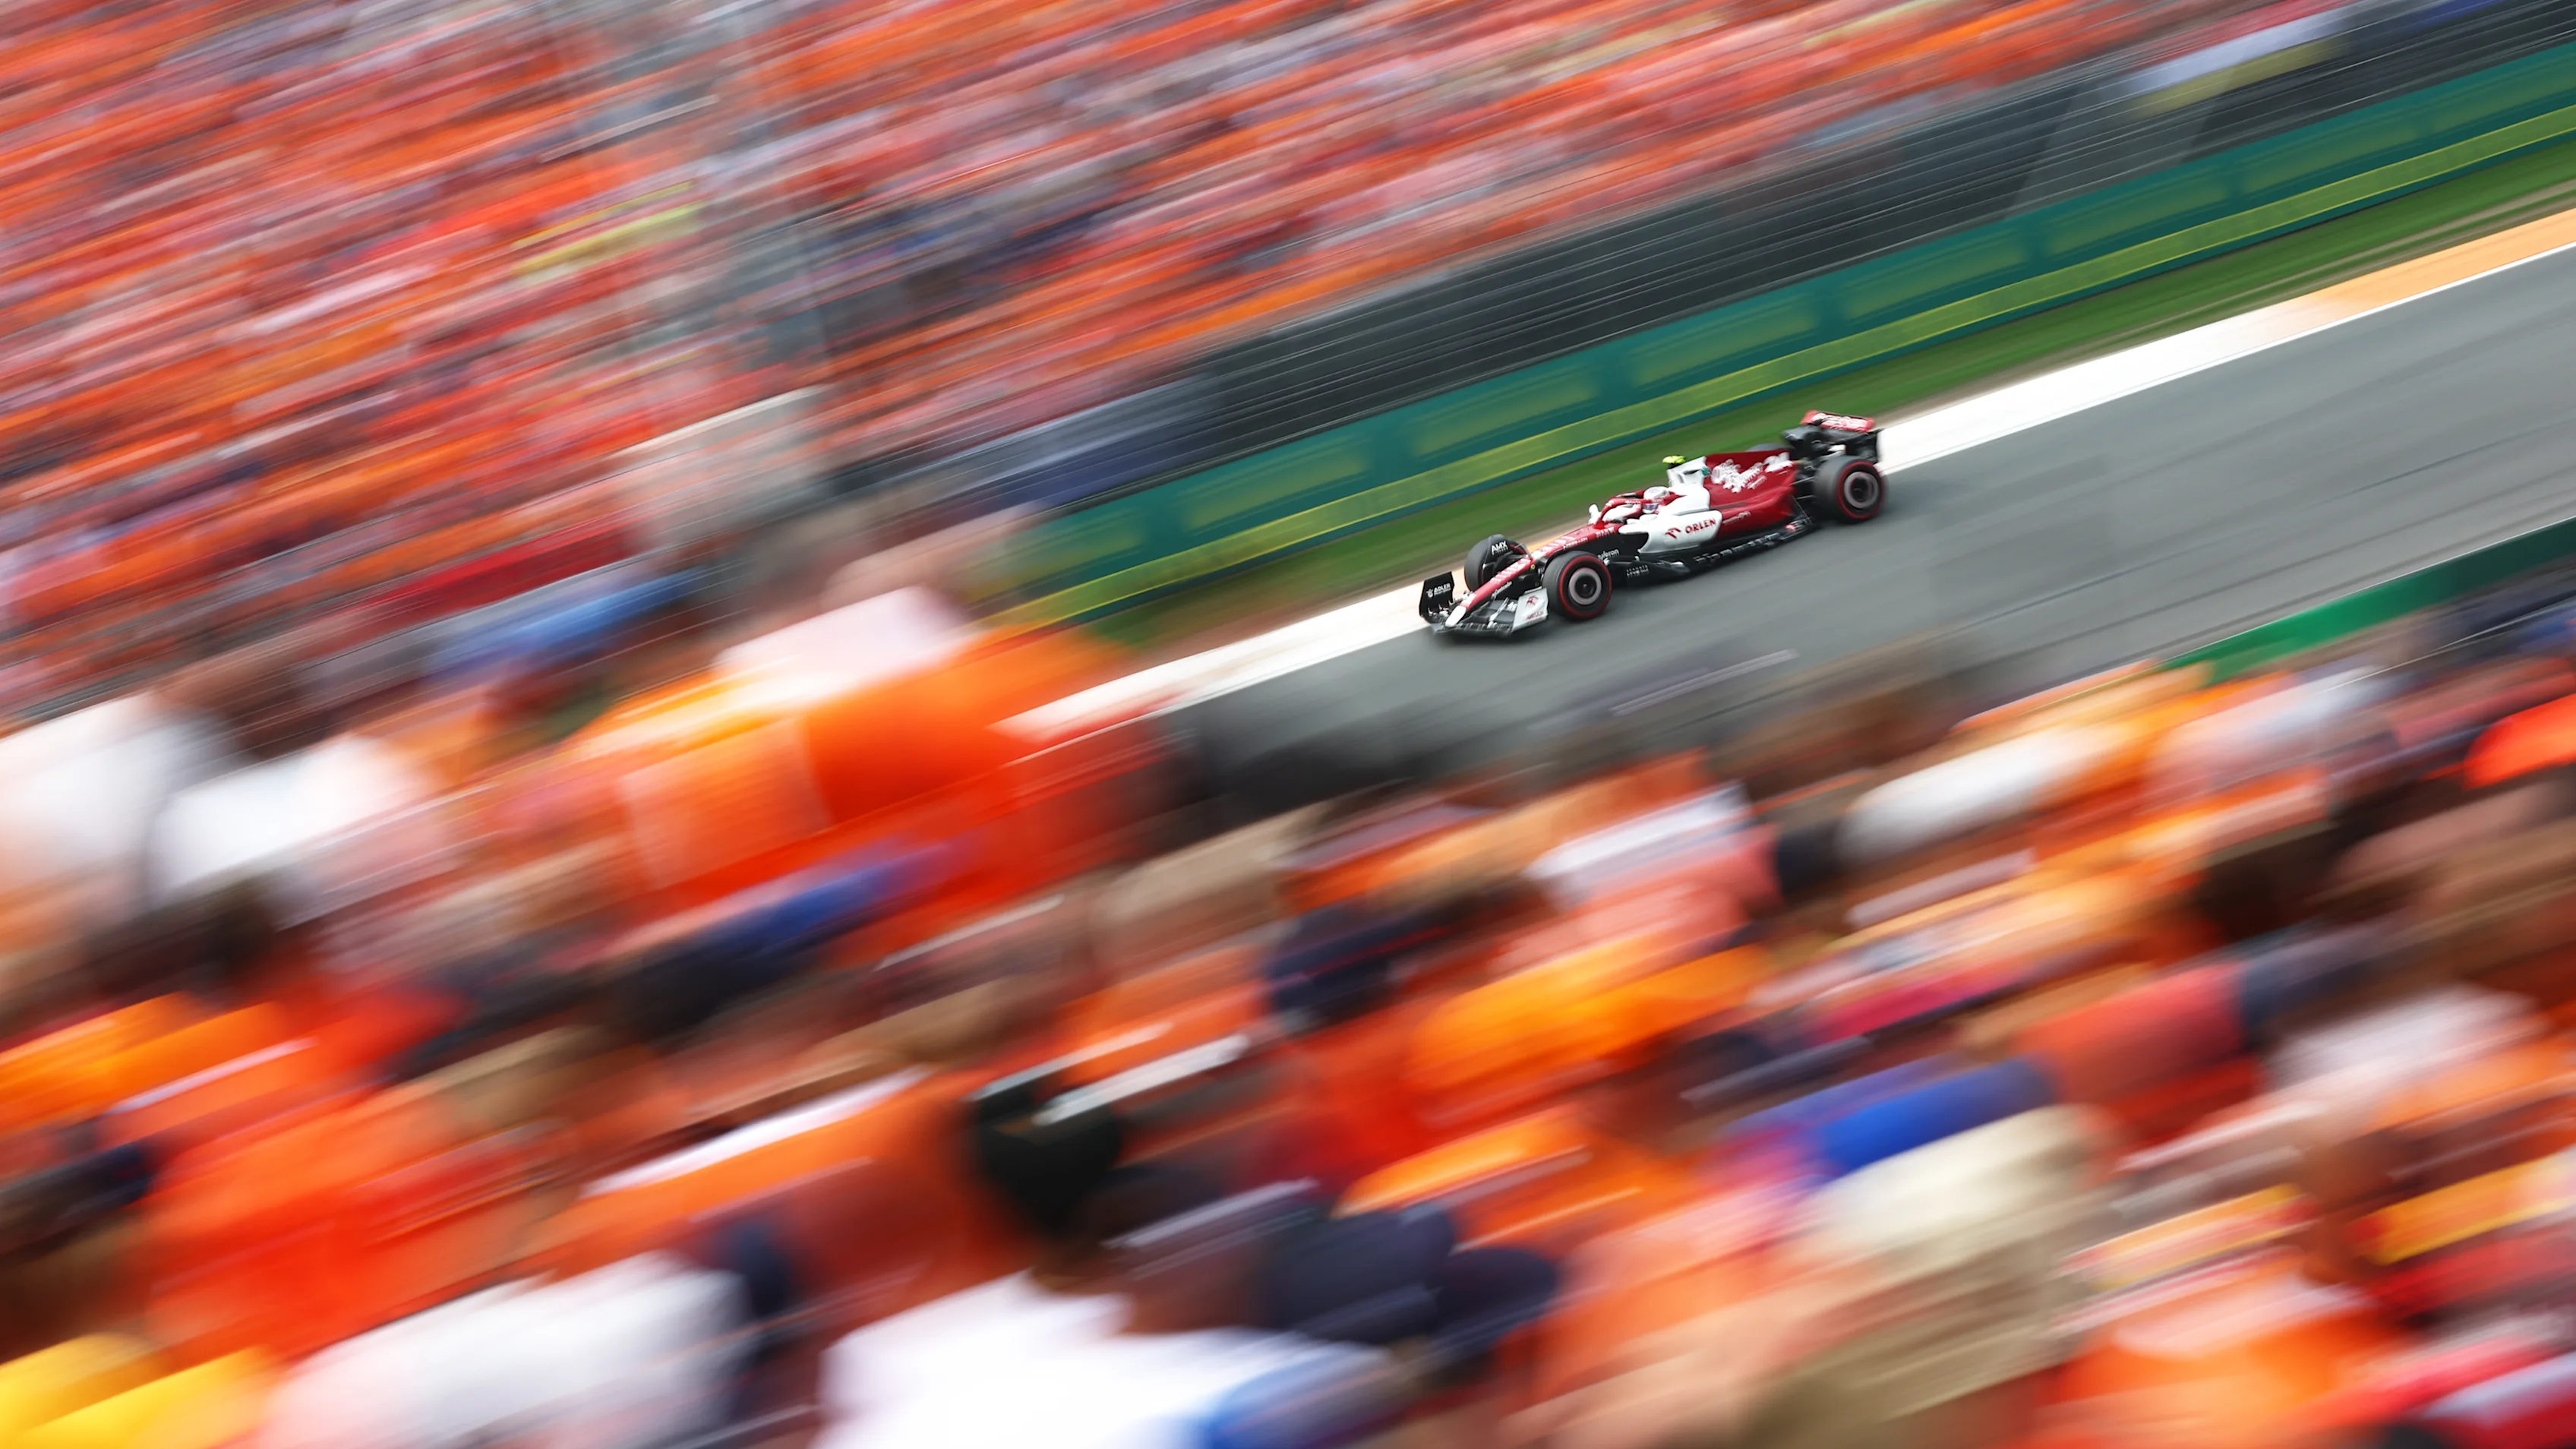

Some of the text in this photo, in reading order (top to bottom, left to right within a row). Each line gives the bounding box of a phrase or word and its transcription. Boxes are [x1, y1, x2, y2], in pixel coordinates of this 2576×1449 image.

[1685, 518, 1716, 534] ORLEN
[1491, 541, 1508, 554] AMX
[1434, 583, 1451, 592] ADLER
